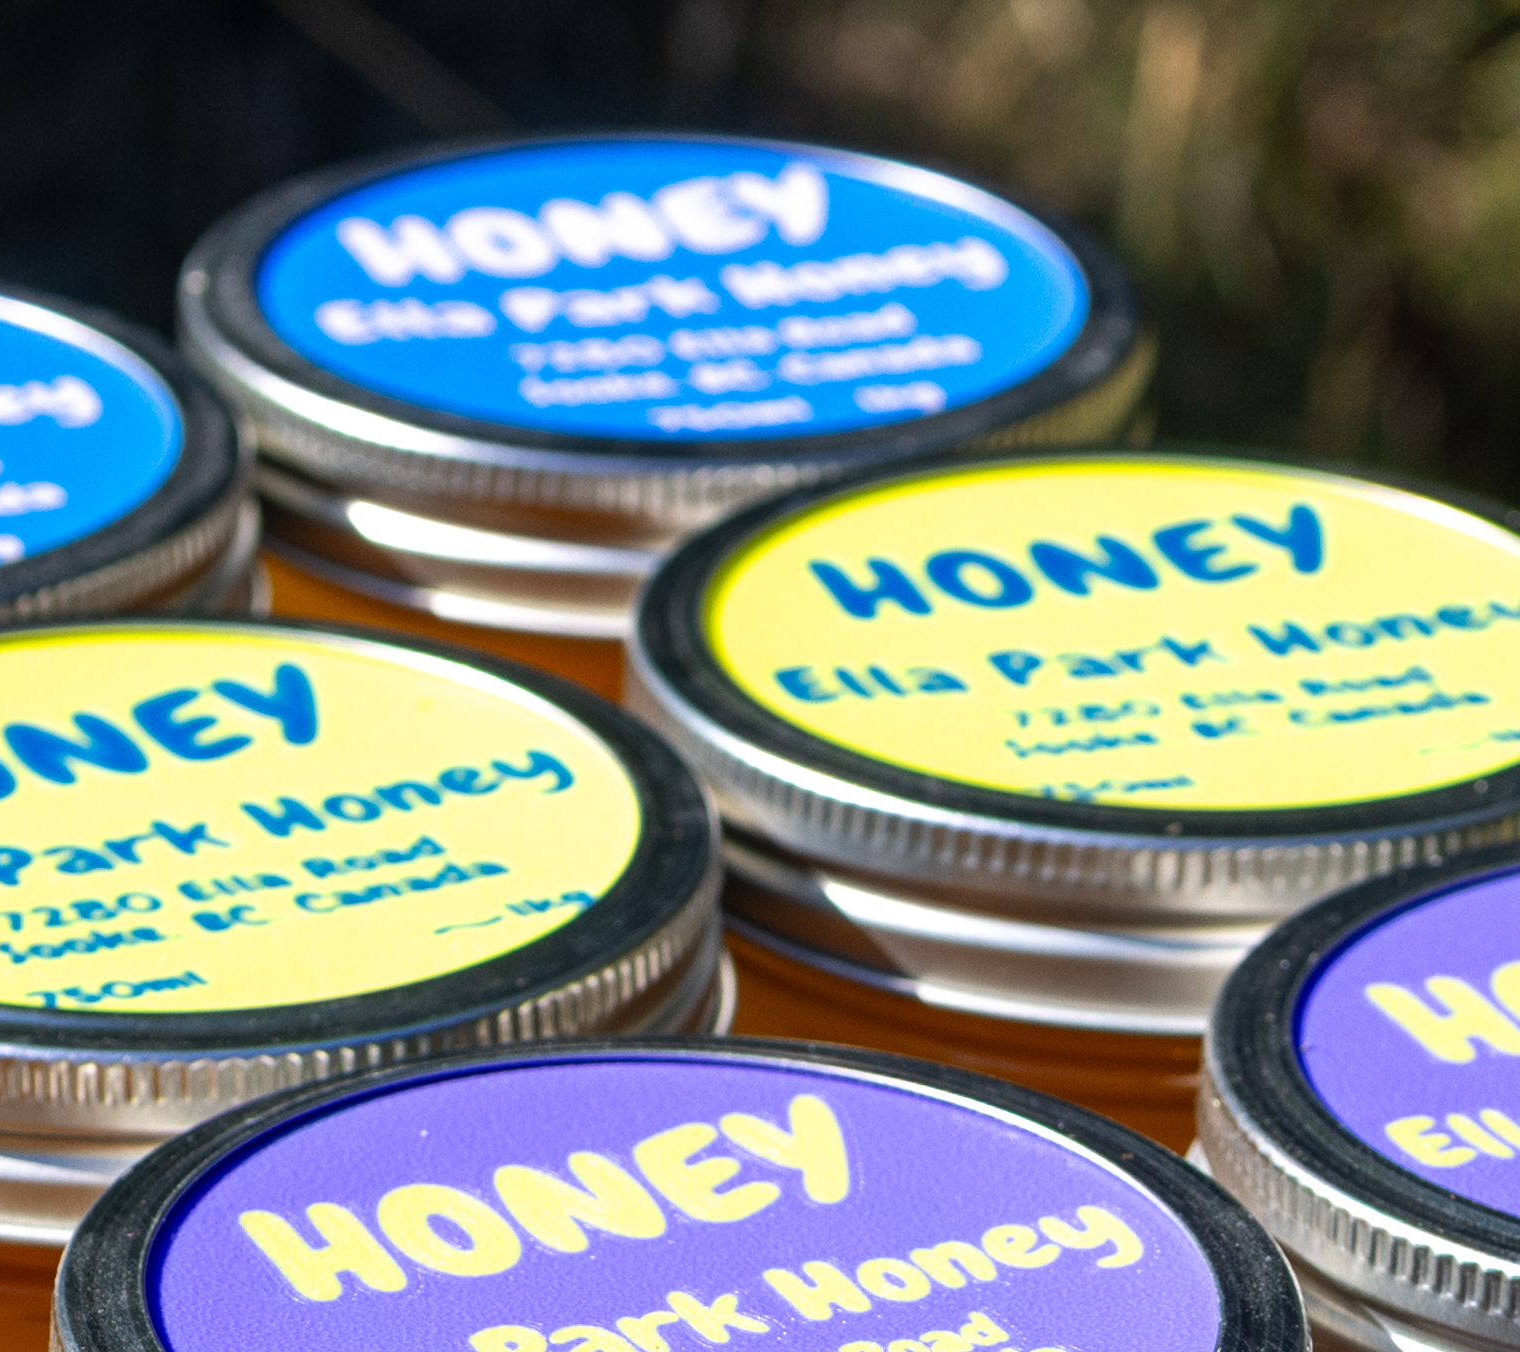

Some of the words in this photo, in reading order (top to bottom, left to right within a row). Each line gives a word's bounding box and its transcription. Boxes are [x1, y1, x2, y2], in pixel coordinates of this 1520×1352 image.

[336, 160, 828, 286] HONEY
[810, 504, 1324, 619] HONEY
[772, 664, 970, 703] Ella
[987, 635, 1226, 686] Park
[241, 751, 574, 837] Honey
[176, 872, 293, 903] Ella
[301, 834, 446, 880] Road
[295, 863, 508, 911] Canada
[240, 1096, 848, 1301] HONEY
[764, 1207, 1142, 1320] Honey
